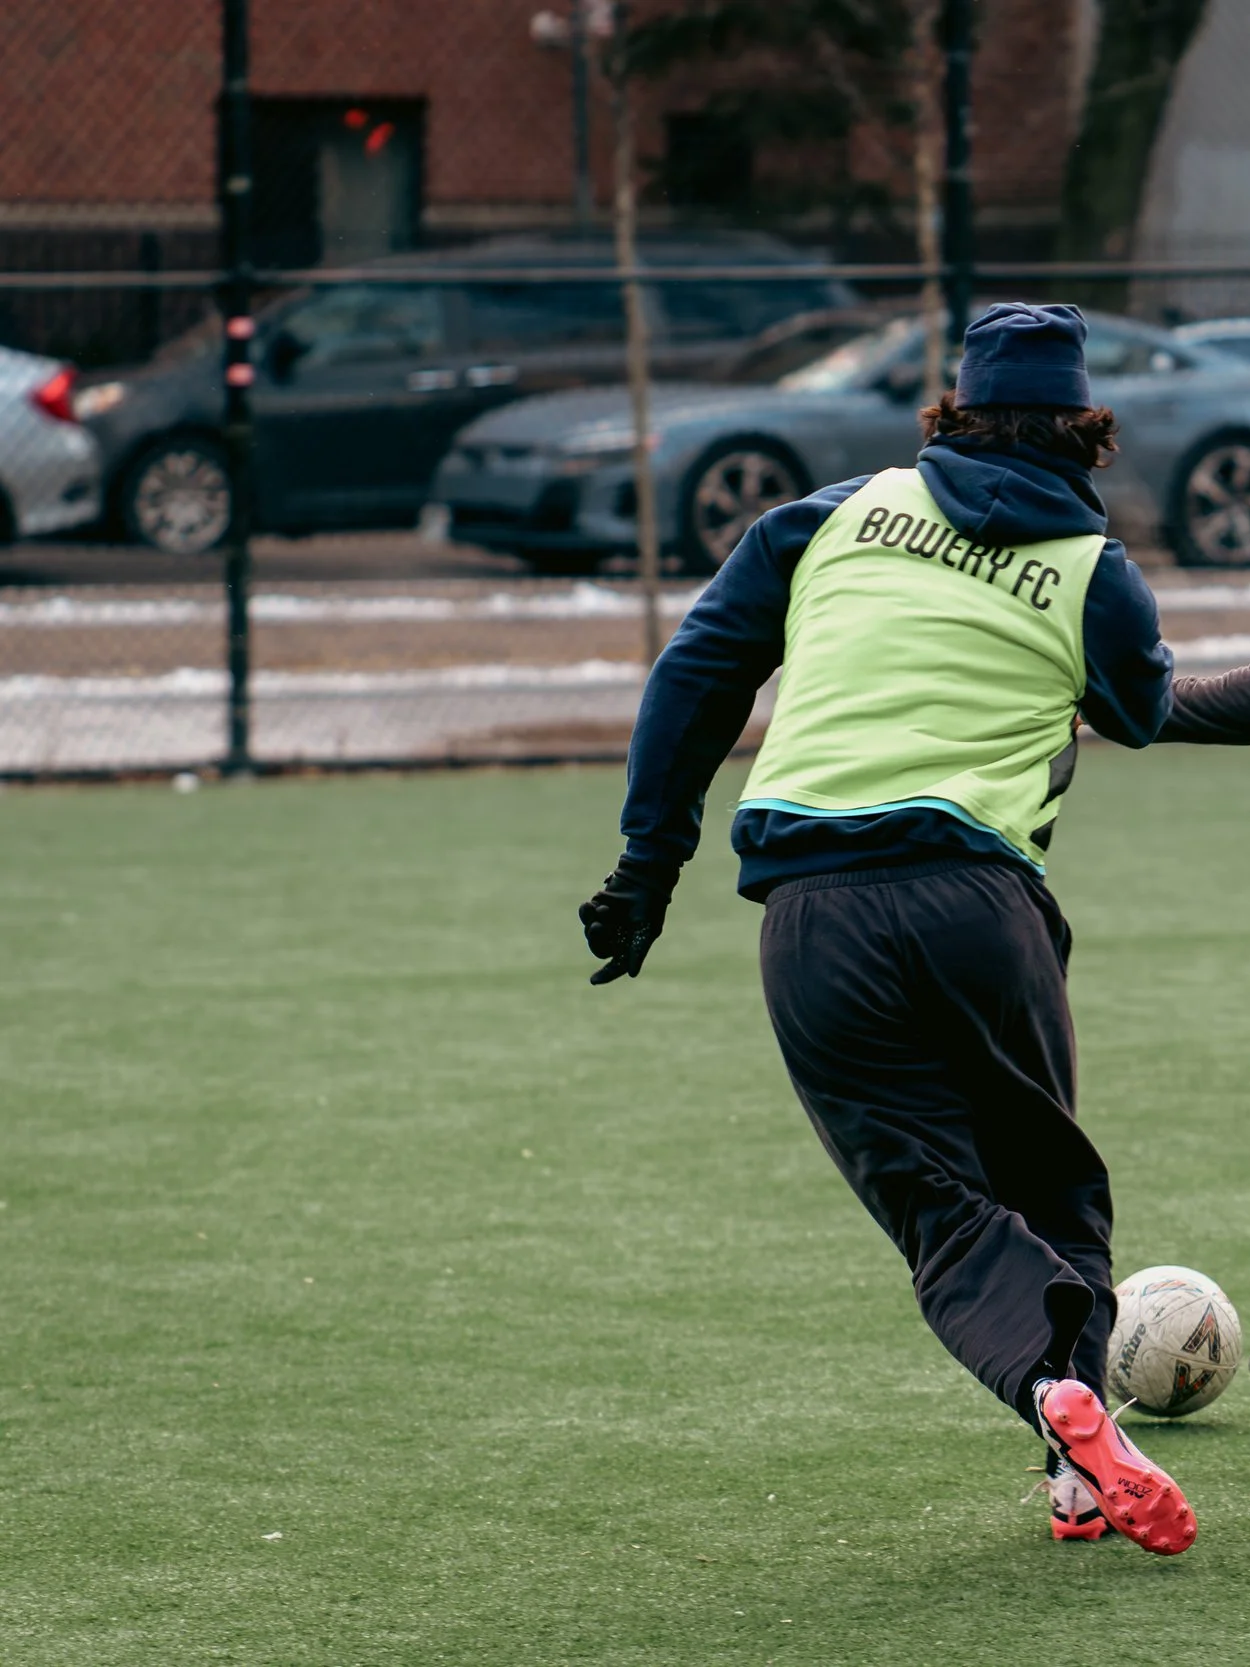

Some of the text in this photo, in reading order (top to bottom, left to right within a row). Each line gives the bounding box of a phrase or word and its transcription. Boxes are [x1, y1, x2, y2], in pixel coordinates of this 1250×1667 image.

[855, 507, 1061, 611] BOWERY FC
[1117, 1477, 1153, 1495] ZOOM
